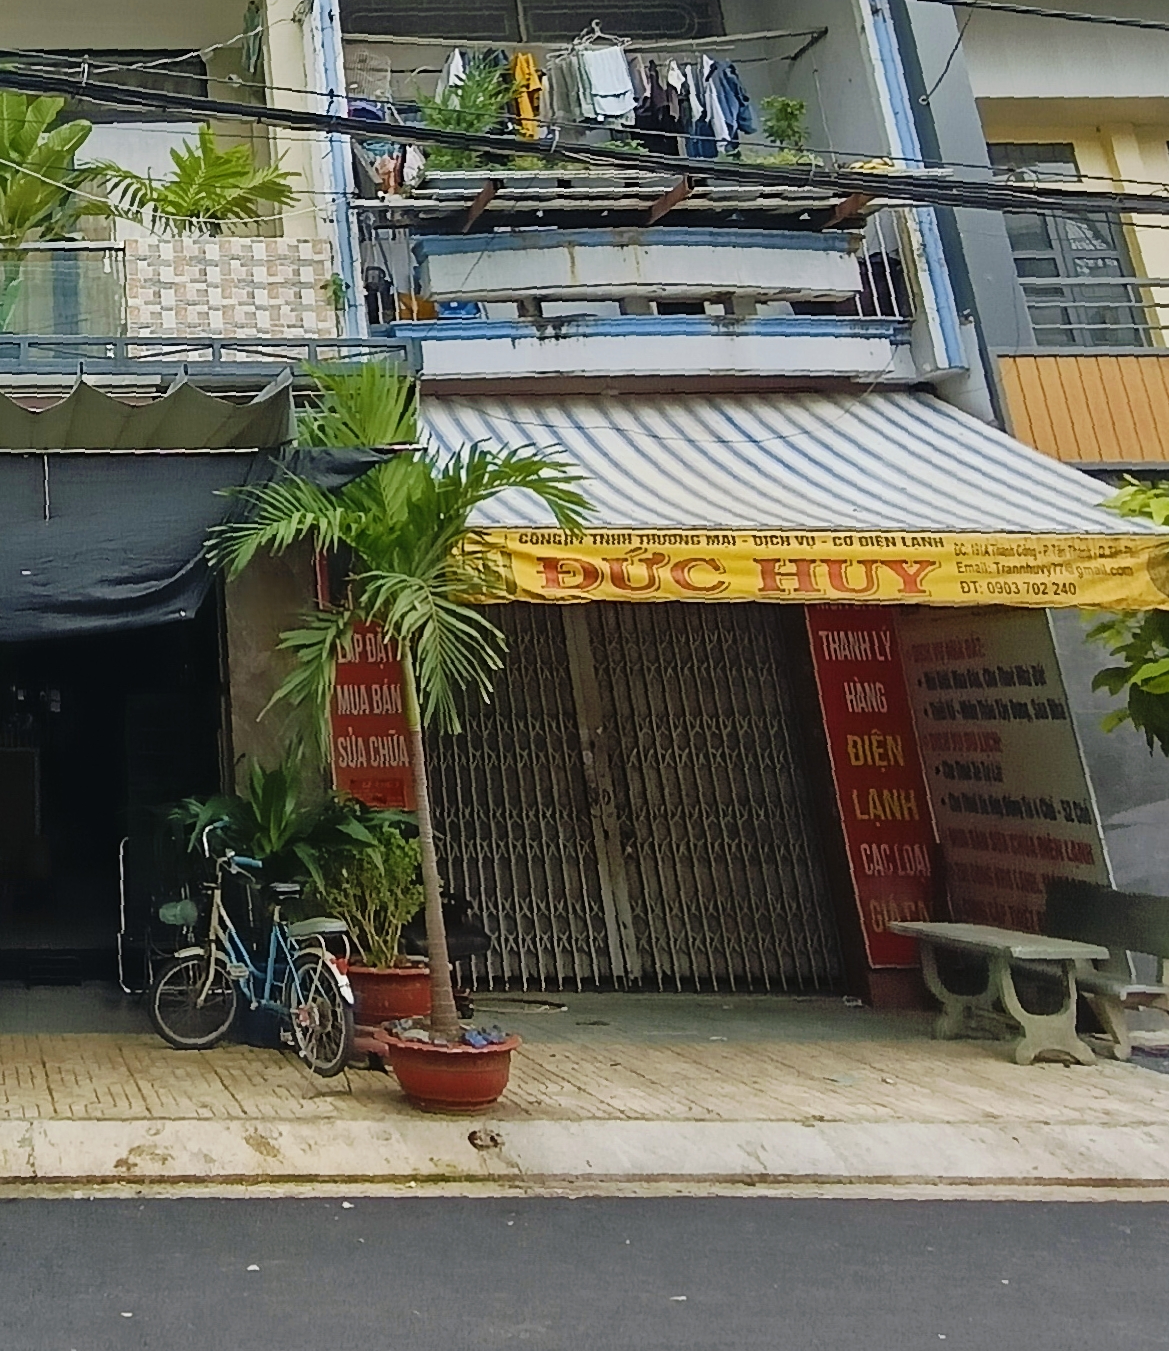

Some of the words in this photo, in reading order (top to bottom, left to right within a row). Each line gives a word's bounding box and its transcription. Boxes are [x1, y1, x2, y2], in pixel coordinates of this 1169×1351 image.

[588, 533, 633, 545] TNHH
[536, 546, 731, 596] ĐỨC
[754, 556, 942, 596] HUY
[956, 561, 993, 574] Email:
[959, 580, 984, 595] ĐT:
[986, 580, 1021, 595] 0903
[1022, 581, 1049, 596] 702
[1051, 581, 1077, 596] 240
[818, 630, 872, 662] THANH
[871, 625, 892, 662] LÝ
[336, 684, 370, 716] MUA
[371, 678, 402, 715] BÁN
[843, 676, 888, 714] HÀNG
[337, 726, 367, 768] SỬA
[369, 729, 410, 768] CHỮA
[847, 729, 904, 773] ĐIỆN
[851, 787, 920, 828] LẠNH
